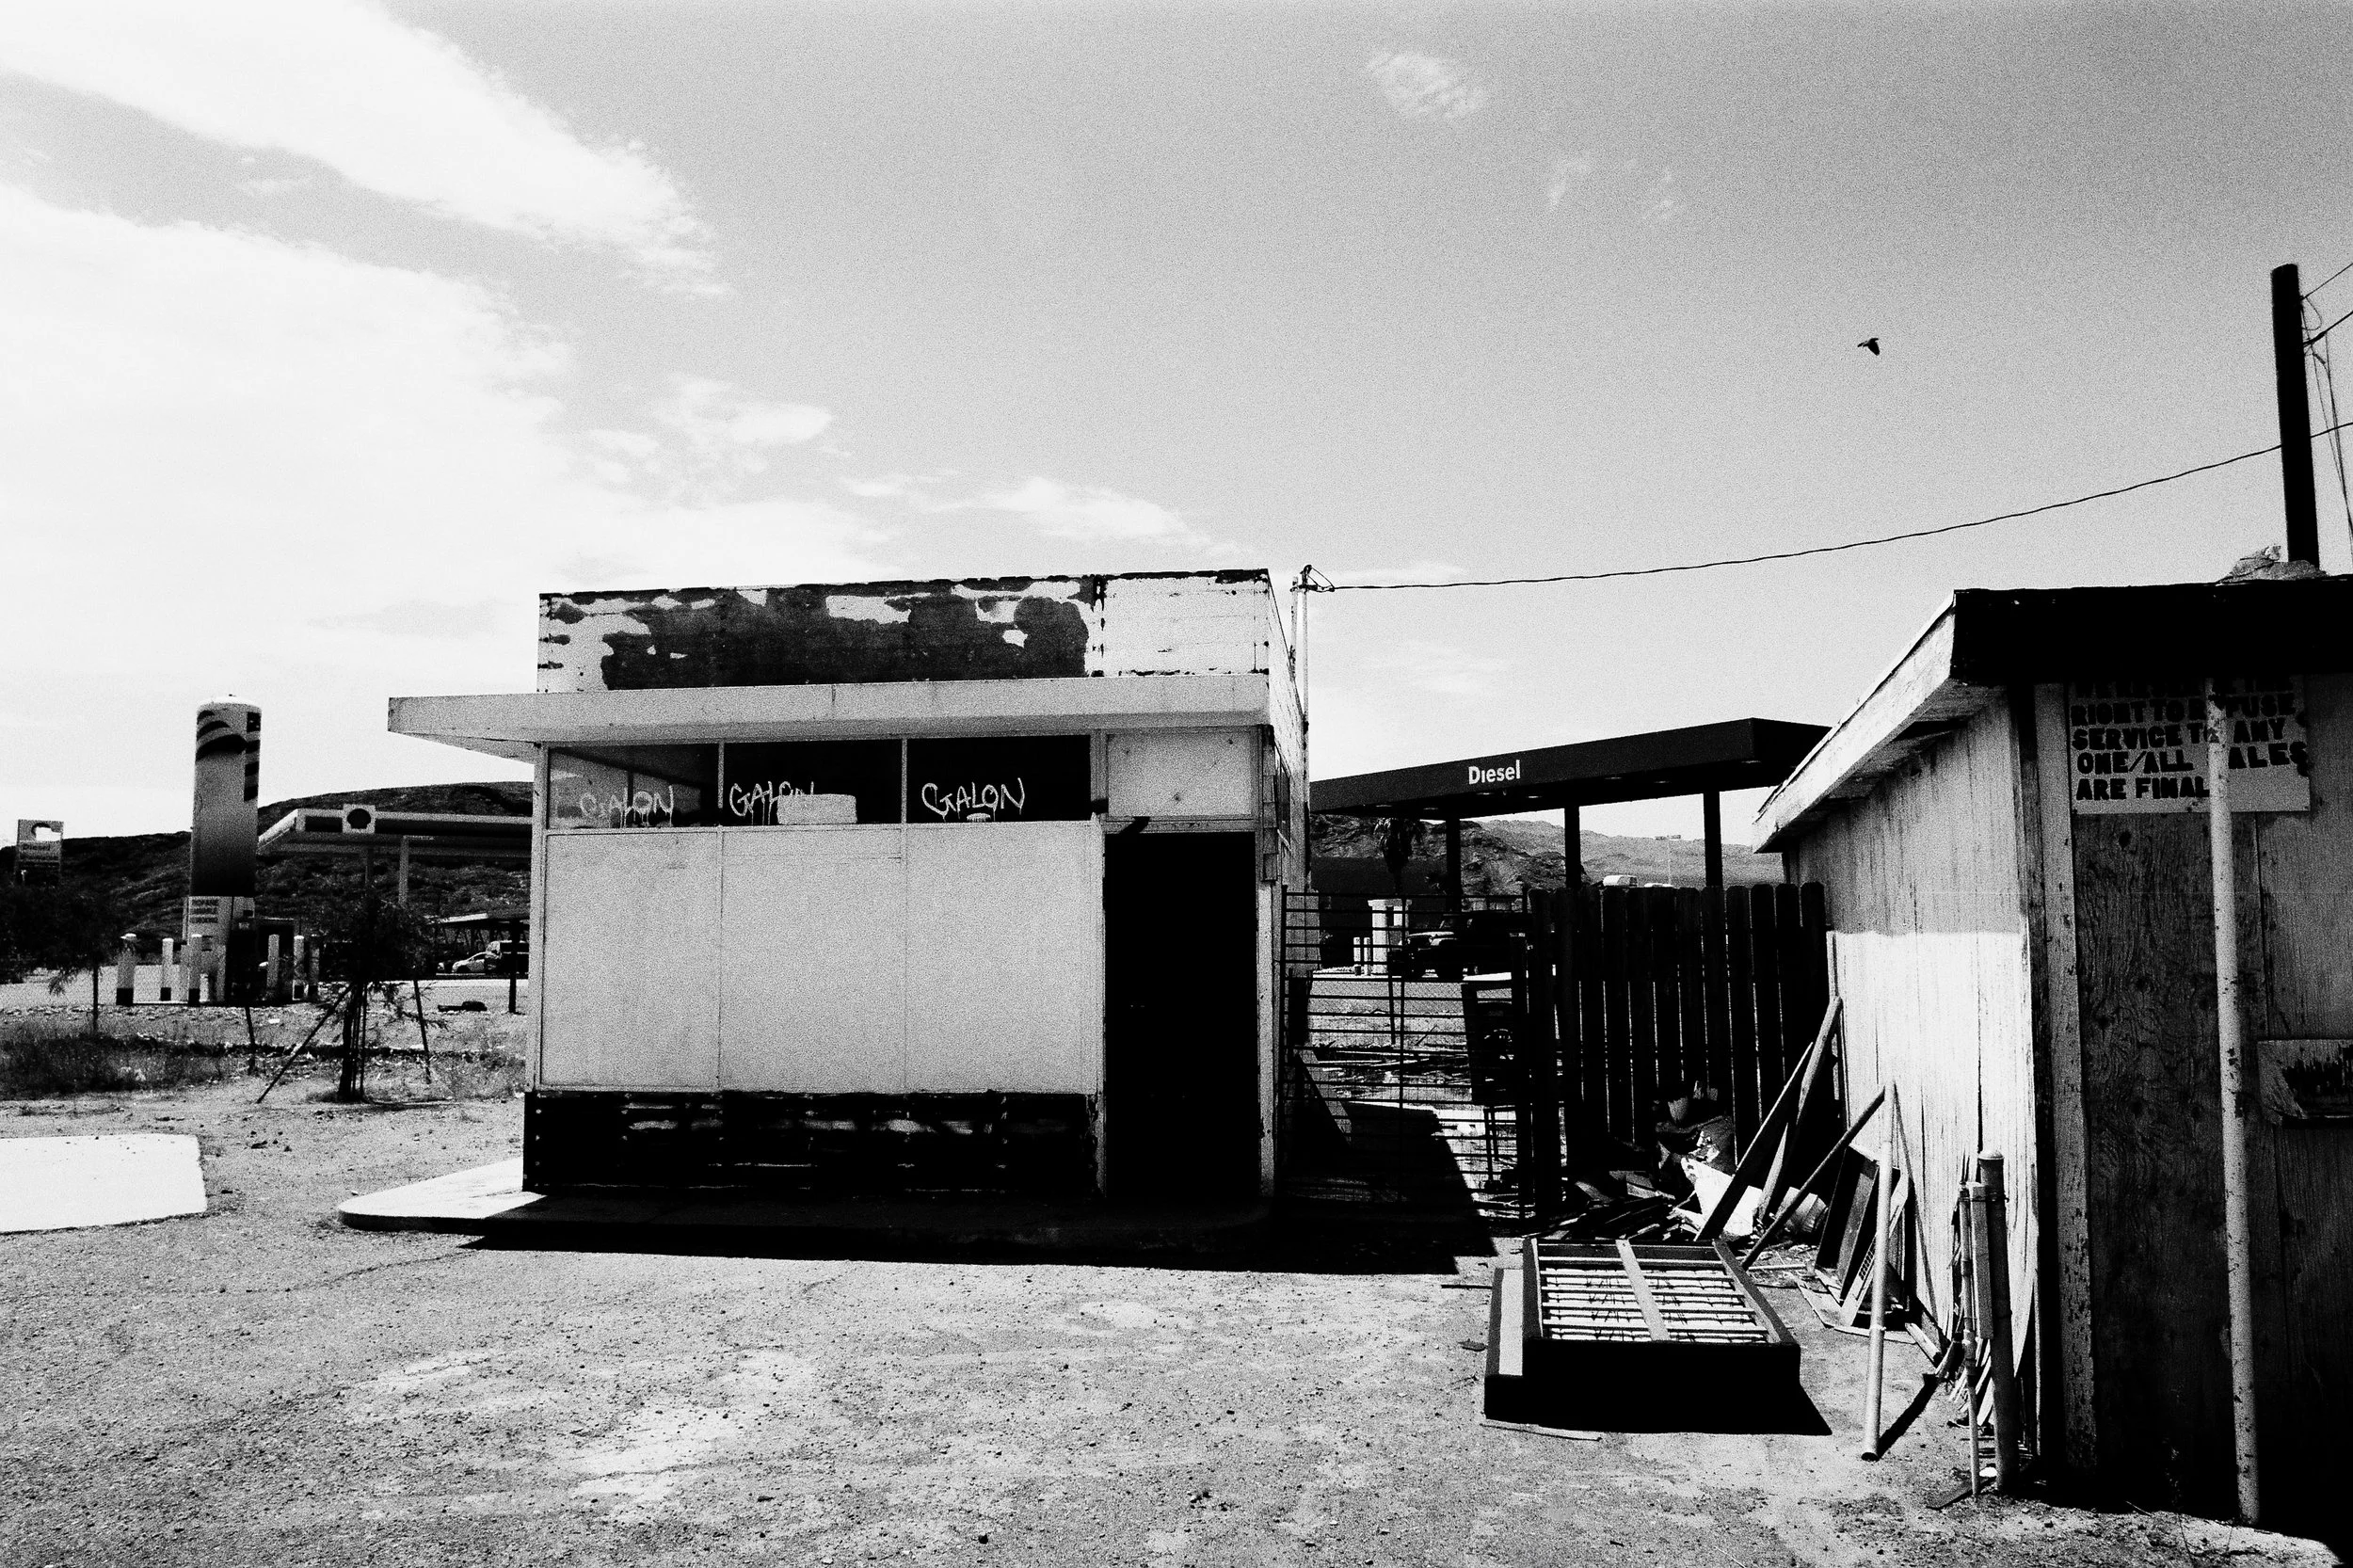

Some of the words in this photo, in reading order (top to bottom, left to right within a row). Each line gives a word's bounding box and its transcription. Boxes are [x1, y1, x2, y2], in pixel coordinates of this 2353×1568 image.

[2188, 693, 2295, 720] RFUSE
[2072, 724, 2183, 750] SERVICE
[2233, 717, 2285, 744] ANY
[2206, 741, 2306, 770] ALES
[1468, 759, 1521, 785] Diesel
[580, 785, 675, 820] GALON
[921, 777, 1025, 819] GALON
[2076, 777, 2127, 801] ARE
[2135, 776, 2210, 800] FINAL
